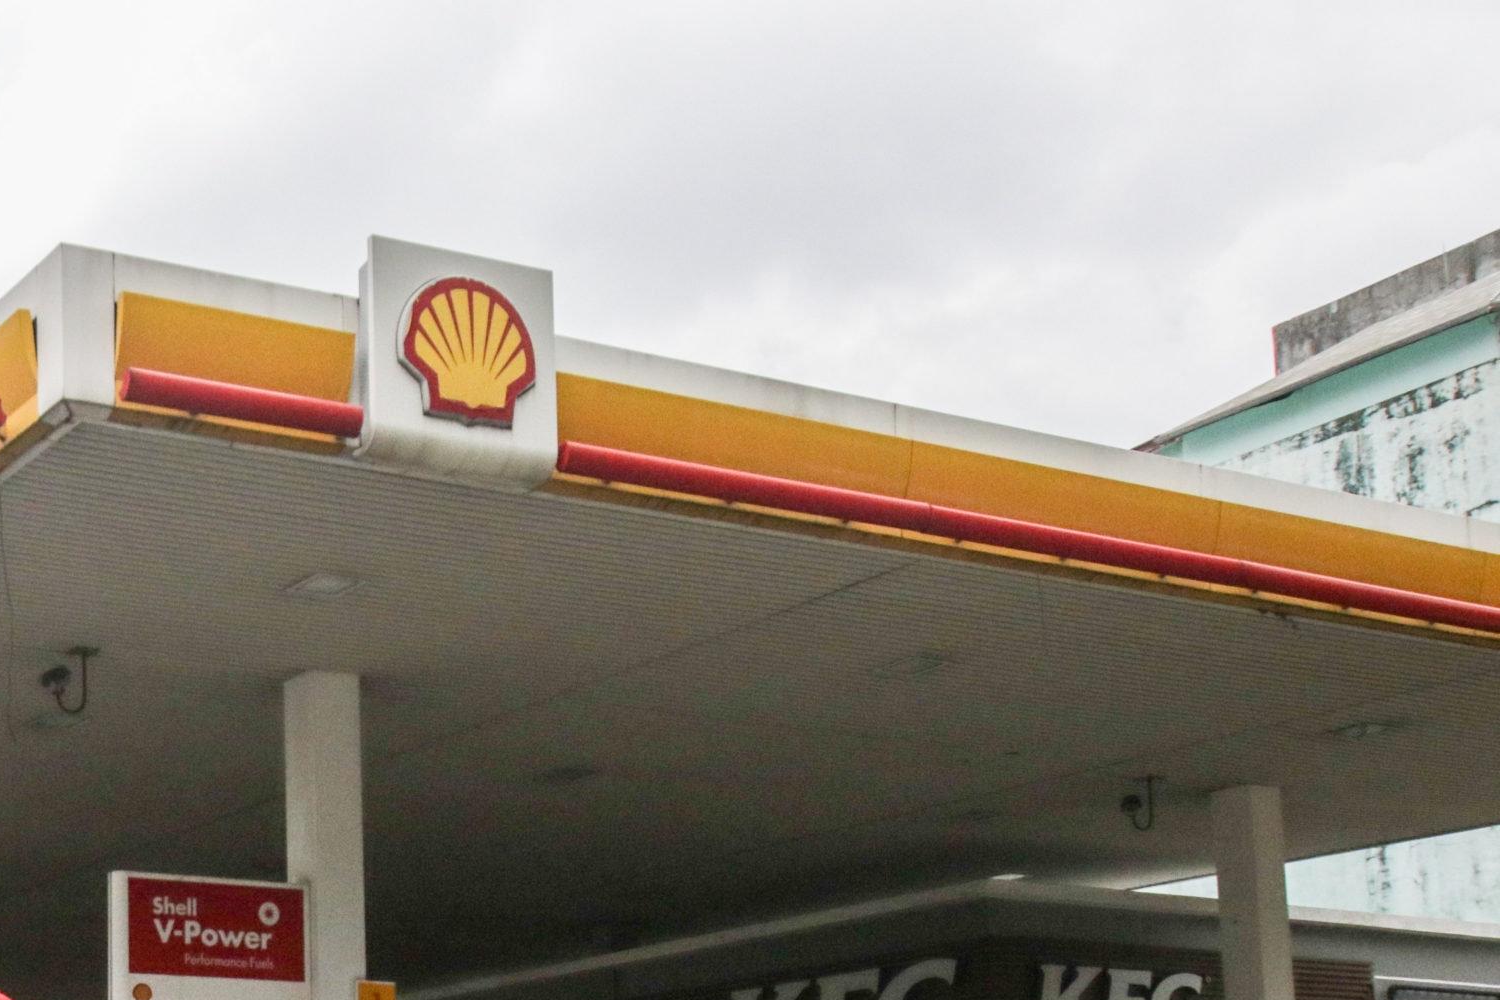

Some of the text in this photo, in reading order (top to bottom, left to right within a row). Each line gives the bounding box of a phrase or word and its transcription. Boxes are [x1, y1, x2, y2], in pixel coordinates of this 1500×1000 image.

[152, 896, 198, 916] Shell
[153, 918, 273, 950] V-Power
[184, 953, 274, 970] Performance Fuels
